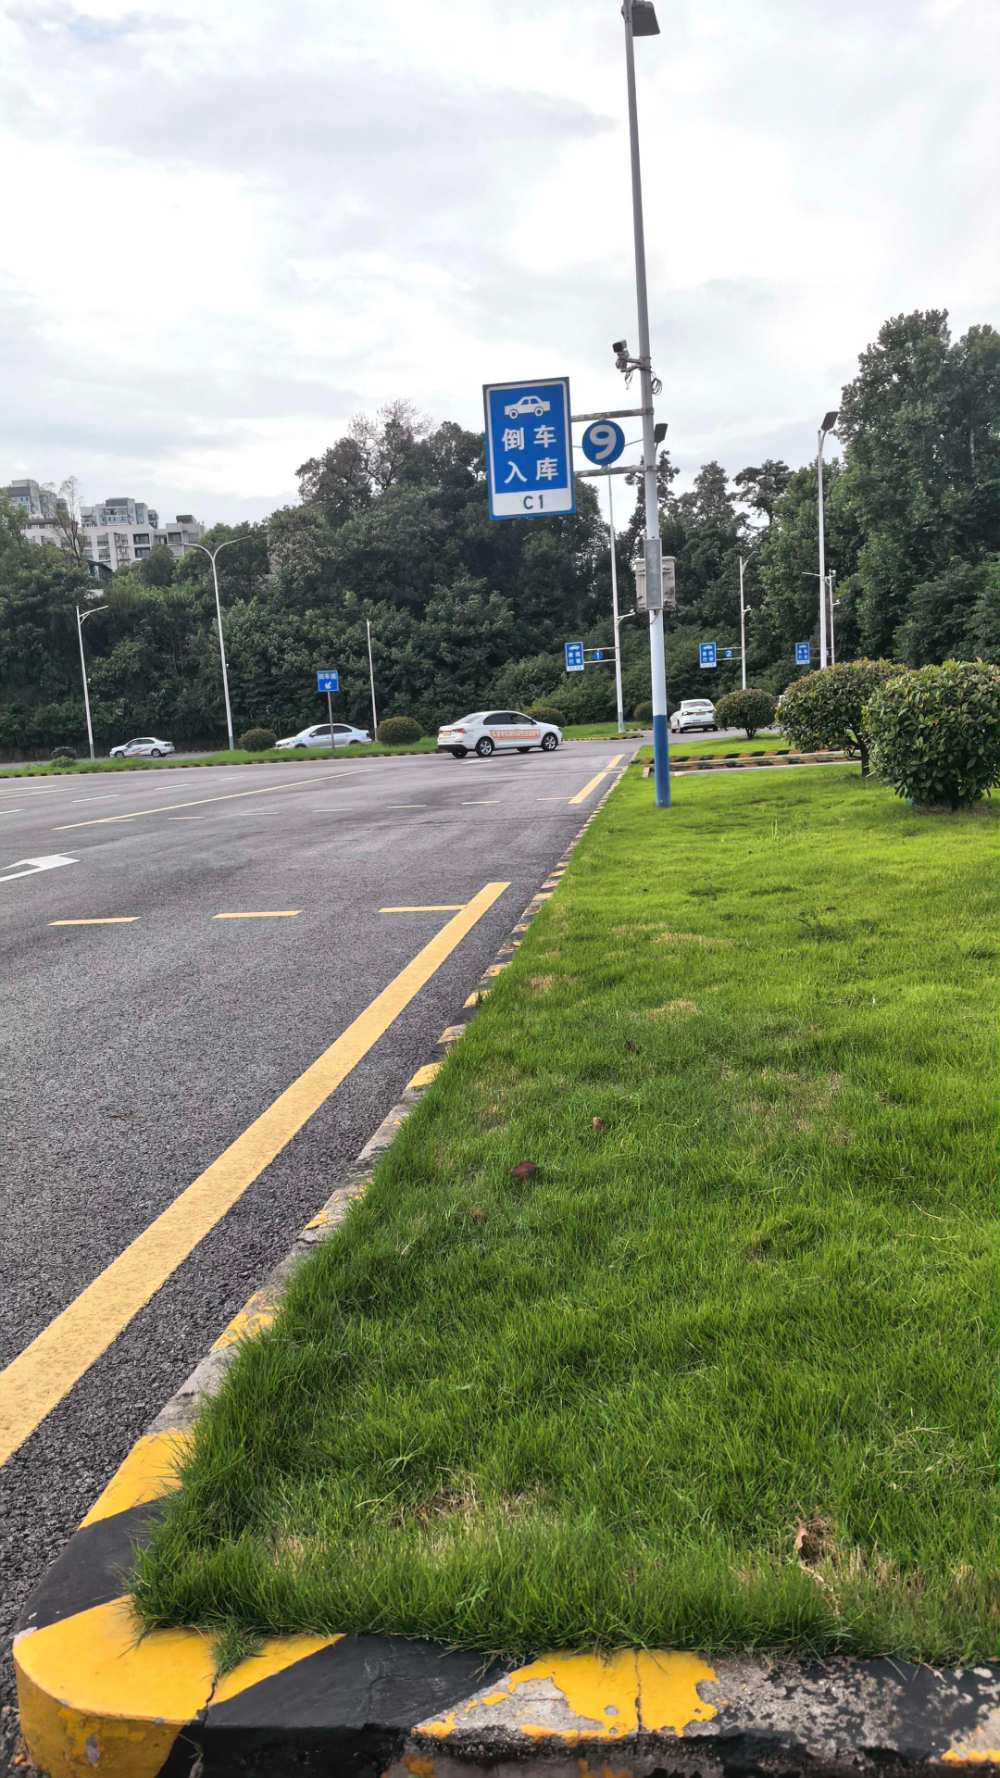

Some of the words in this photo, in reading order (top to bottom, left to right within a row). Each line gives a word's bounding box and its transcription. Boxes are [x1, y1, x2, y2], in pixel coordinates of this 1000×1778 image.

[502, 425, 557, 451] 倒车
[589, 424, 617, 460] 9
[504, 457, 559, 484] 入库
[523, 494, 544, 510] C1
